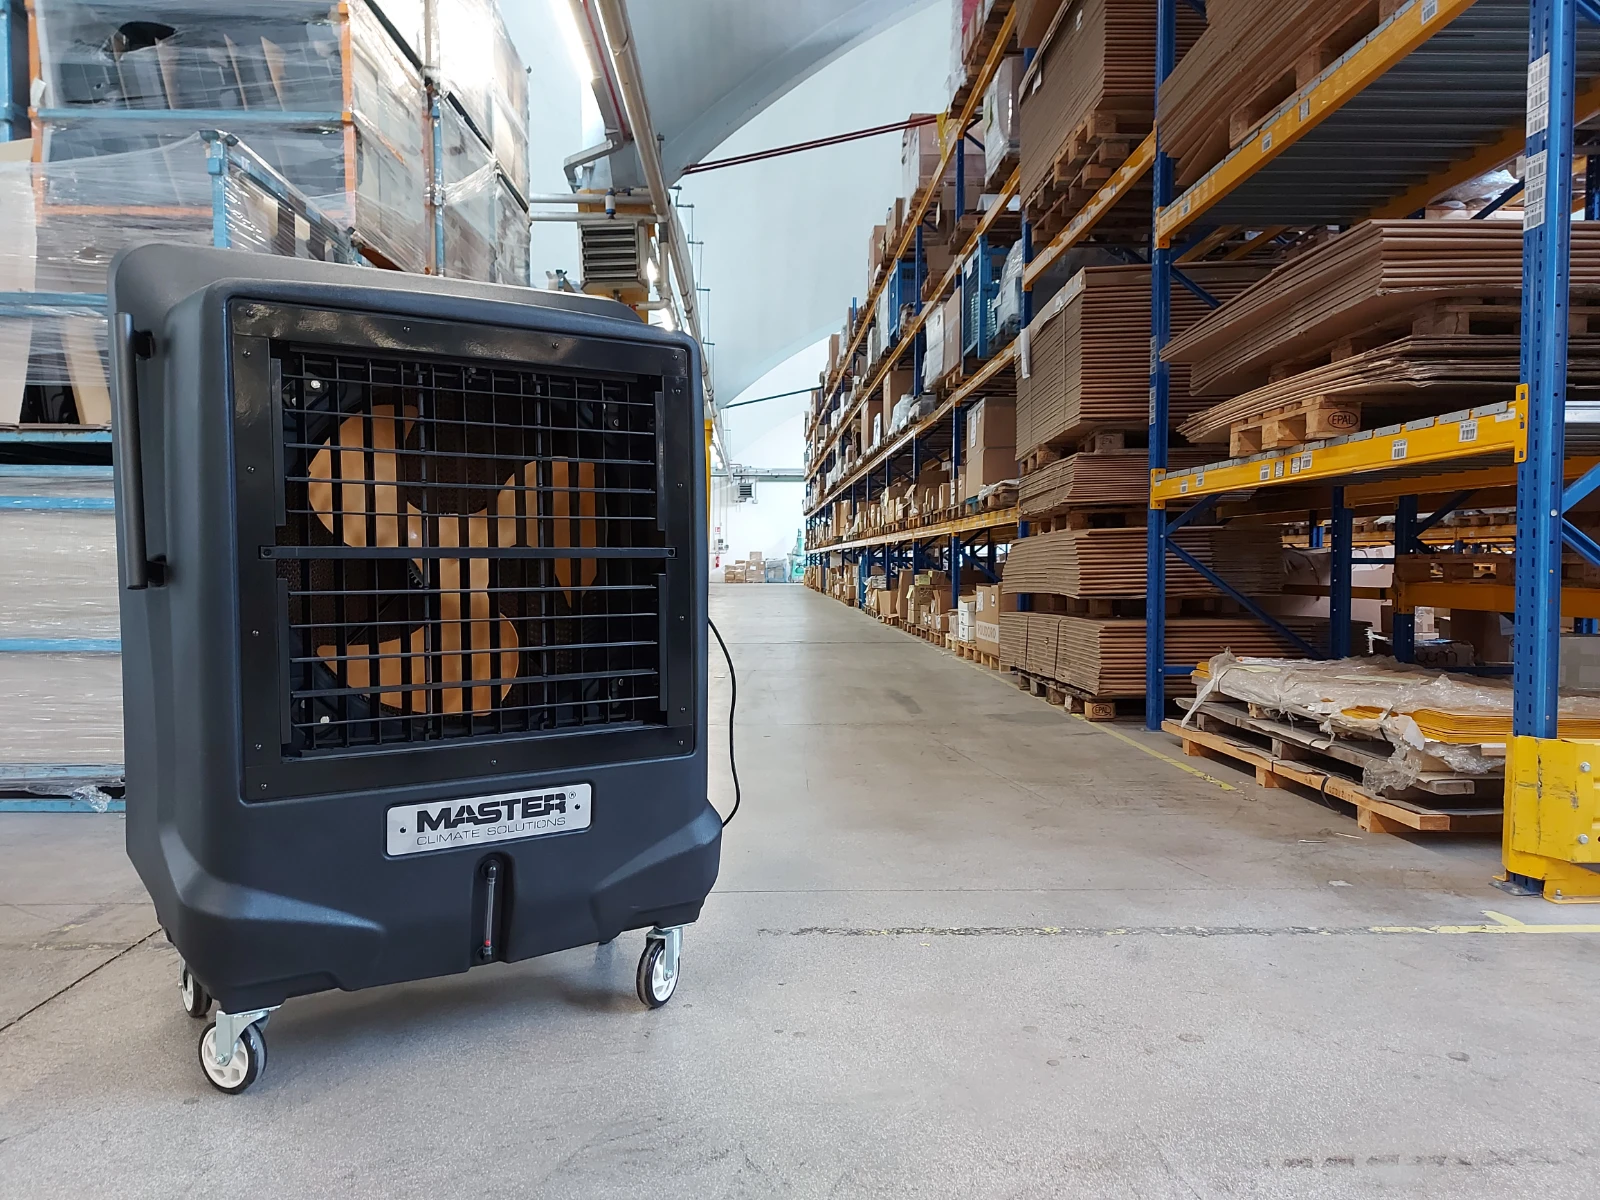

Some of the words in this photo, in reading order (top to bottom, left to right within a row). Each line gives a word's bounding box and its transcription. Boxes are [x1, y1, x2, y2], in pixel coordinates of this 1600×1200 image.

[1331, 414, 1354, 425] EPAL
[416, 792, 567, 833] MASTER
[416, 828, 481, 846] CLIMATE
[486, 816, 567, 837] SOLUTIONS
